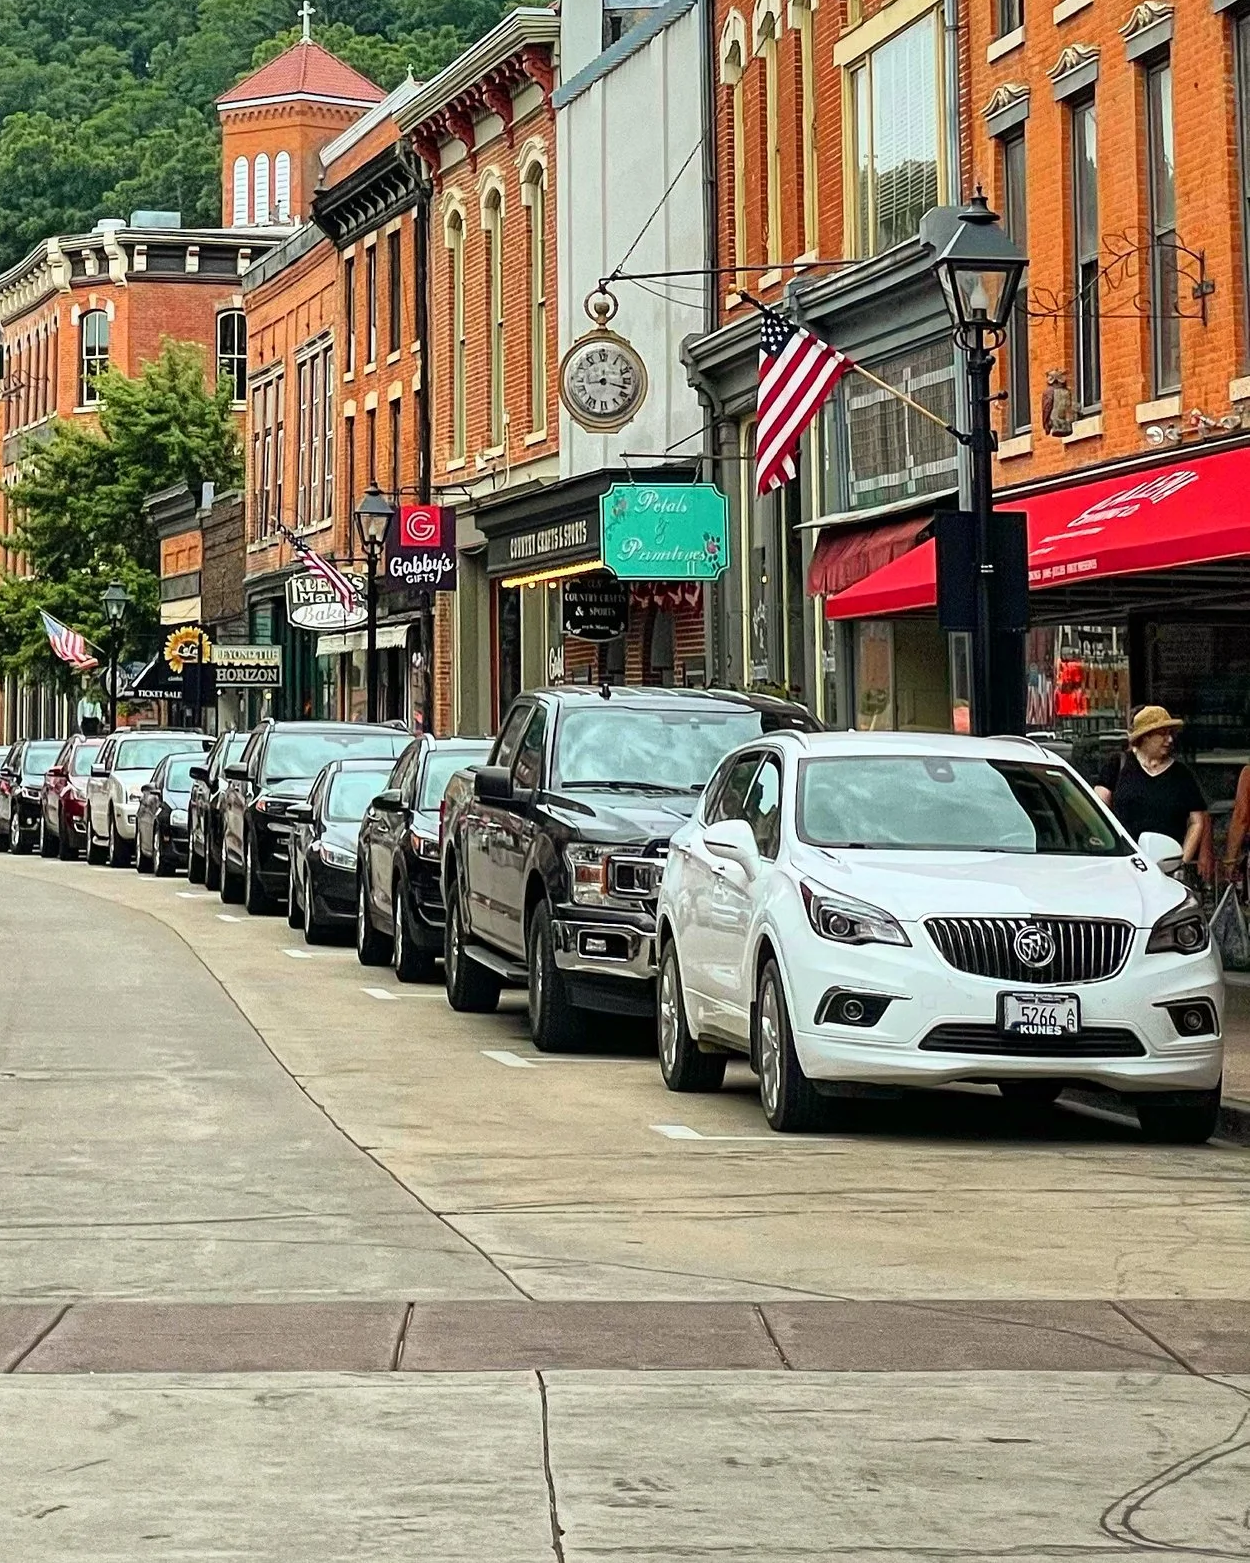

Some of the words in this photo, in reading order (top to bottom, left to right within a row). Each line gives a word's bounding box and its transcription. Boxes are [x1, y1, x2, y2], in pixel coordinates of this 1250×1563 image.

[634, 489, 688, 514] Petals
[406, 511, 435, 541] G
[616, 537, 706, 562] Primitives
[390, 552, 454, 584] Gabby's
[405, 573, 435, 584] GIFTS
[575, 606, 584, 616] &
[589, 606, 617, 616] SPORTS
[216, 668, 278, 682] HORIZON
[138, 690, 164, 698] TICKET
[1021, 1006, 1057, 1027] 5266
[1019, 1024, 1062, 1036] KUNES
